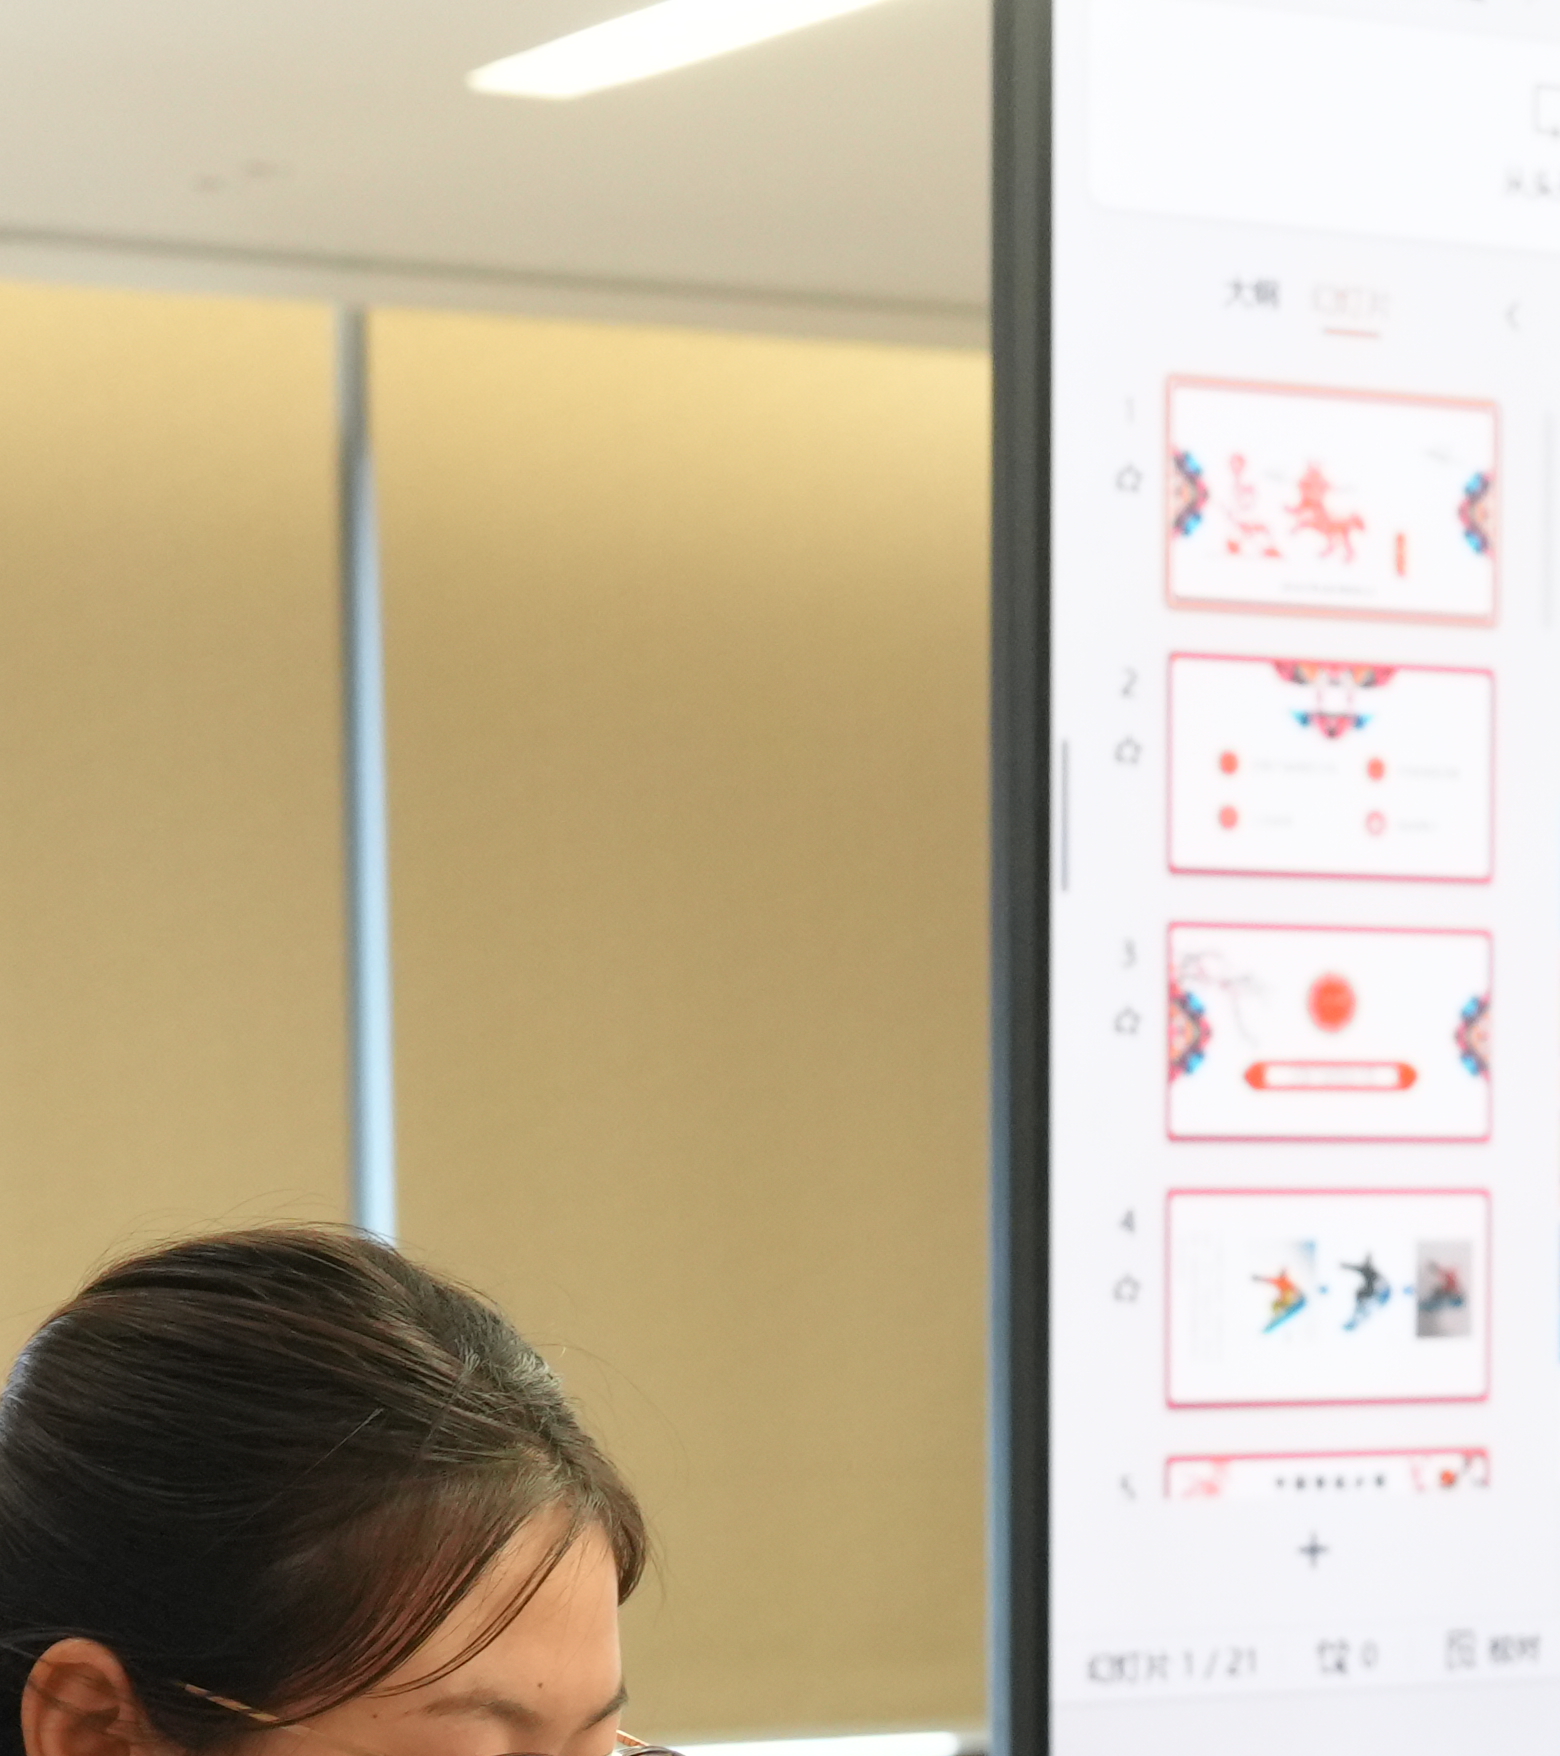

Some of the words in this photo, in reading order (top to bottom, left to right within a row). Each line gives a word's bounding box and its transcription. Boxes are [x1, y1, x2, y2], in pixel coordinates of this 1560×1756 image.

[1121, 667, 1138, 699] 2
[1121, 939, 1137, 969] 3
[1119, 1208, 1136, 1235] 4
[1086, 1649, 1169, 1686] 幻灯片
[1225, 1647, 1258, 1678] 21
